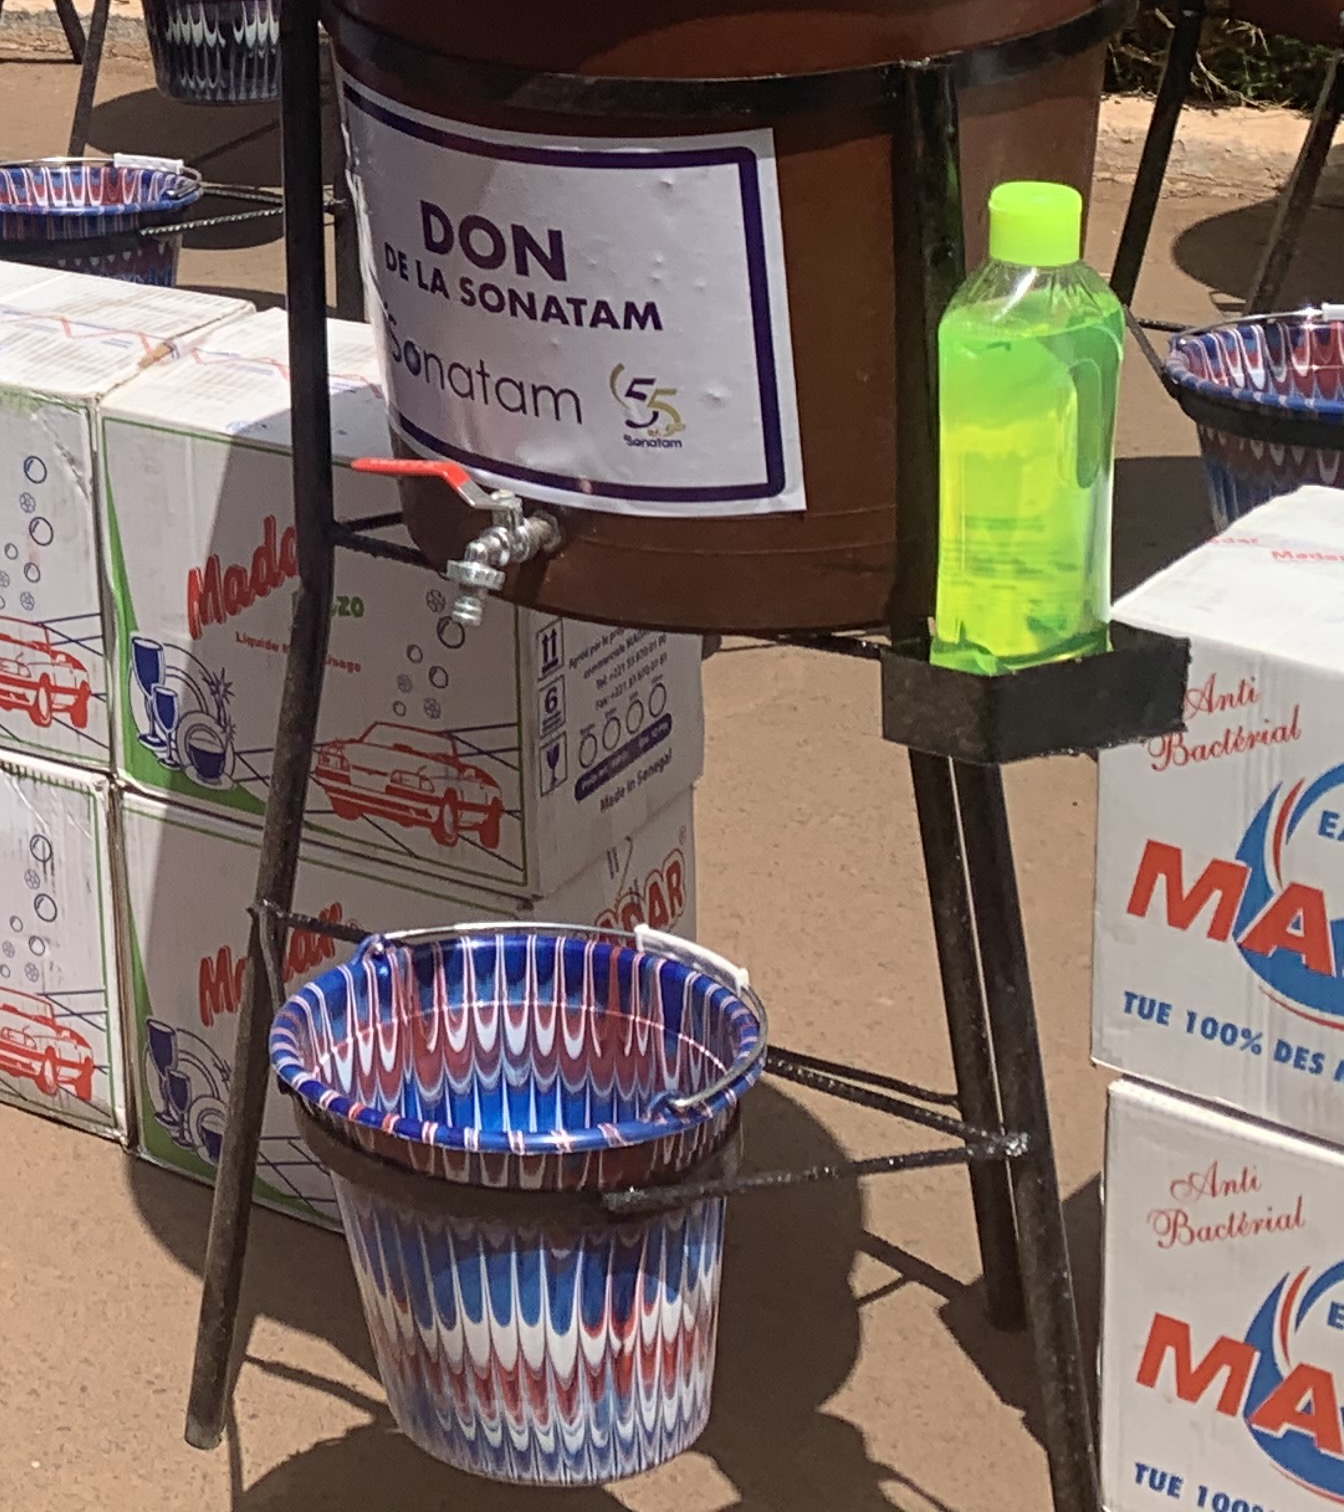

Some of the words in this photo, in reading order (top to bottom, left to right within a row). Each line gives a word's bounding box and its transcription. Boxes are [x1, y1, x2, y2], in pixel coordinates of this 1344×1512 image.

[420, 199, 568, 282] DON
[384, 241, 409, 282] DE
[415, 260, 450, 301] LA
[458, 276, 664, 331] SONATAM
[613, 367, 685, 437] 55
[187, 514, 299, 641] Mada
[544, 686, 558, 714] 6
[1184, 672, 1260, 721] Anti
[1143, 704, 1302, 772] Bactérial
[1123, 990, 1173, 1026] TUE
[1187, 1009, 1263, 1056] 100%
[1274, 1039, 1326, 1075] DES
[1169, 1159, 1263, 1203] Anti
[1146, 1193, 1306, 1250] Bactérial
[1134, 1461, 1184, 1499] TUE
[1198, 1483, 1275, 1512] 100
